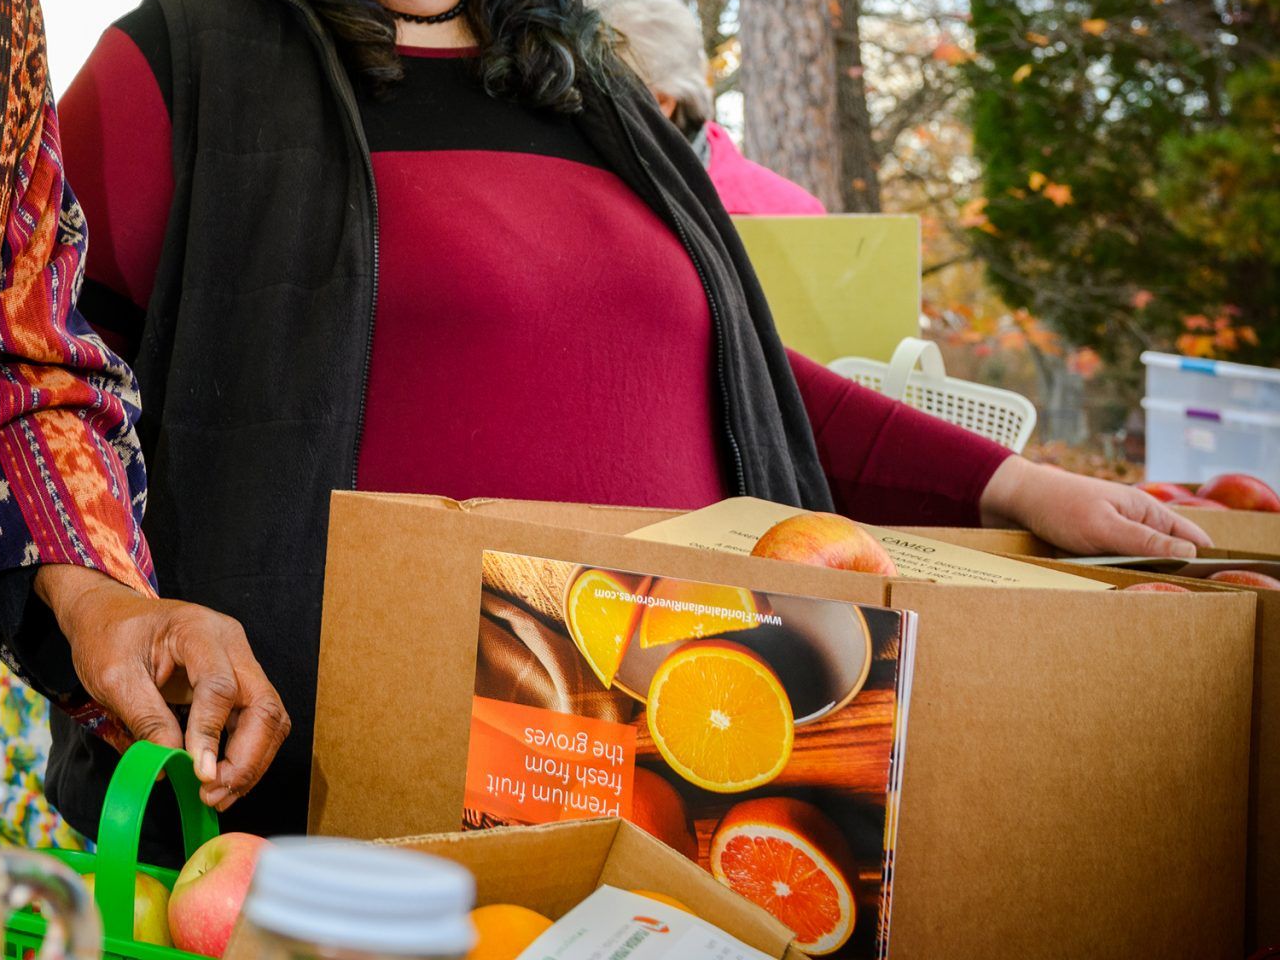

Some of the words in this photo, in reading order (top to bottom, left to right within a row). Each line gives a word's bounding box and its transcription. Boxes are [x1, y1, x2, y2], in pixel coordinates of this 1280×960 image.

[882, 536, 936, 553] CAMEO
[594, 588, 782, 627] www.FloridaIndianRiverGroves.com
[524, 727, 588, 754] groves
[592, 740, 625, 767] the
[525, 754, 570, 785] from
[576, 765, 623, 796] fresh
[486, 773, 526, 804] fruit
[532, 783, 620, 818] Premium
